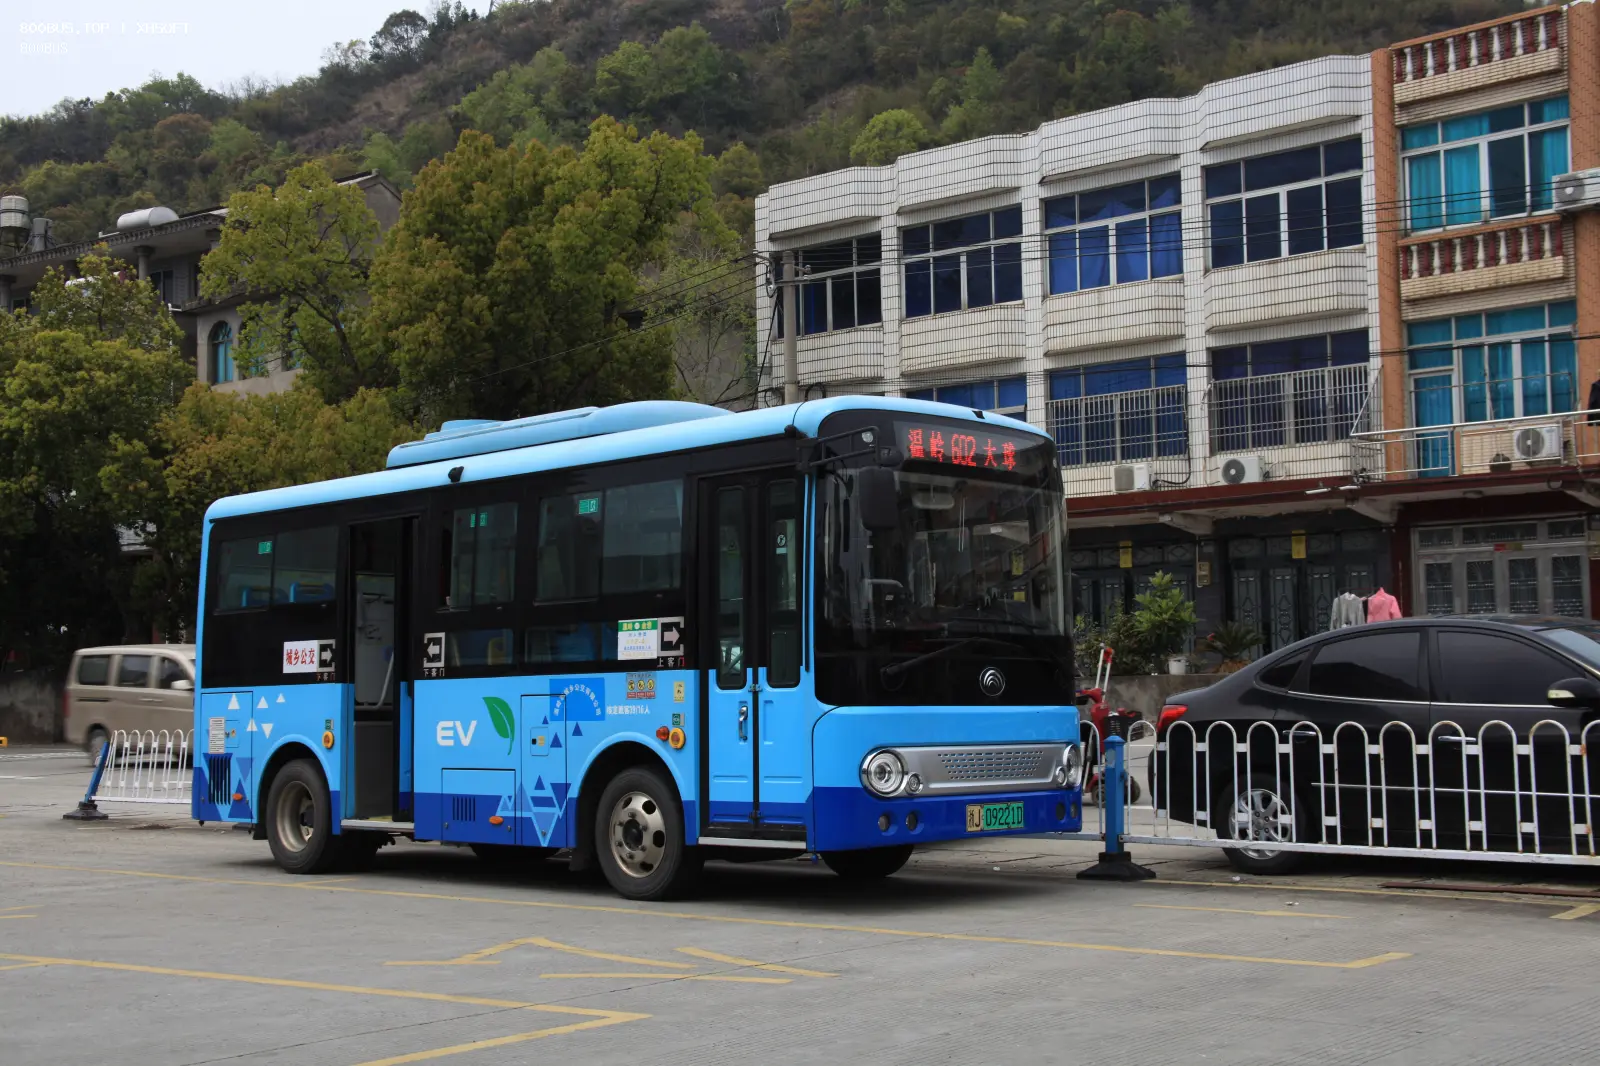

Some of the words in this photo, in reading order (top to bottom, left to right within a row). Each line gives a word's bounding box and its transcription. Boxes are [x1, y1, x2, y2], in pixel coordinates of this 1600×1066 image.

[951, 433, 977, 467] 602
[286, 647, 315, 666] 城乡公交
[657, 656, 685, 668] 上客门
[436, 720, 477, 747] EV
